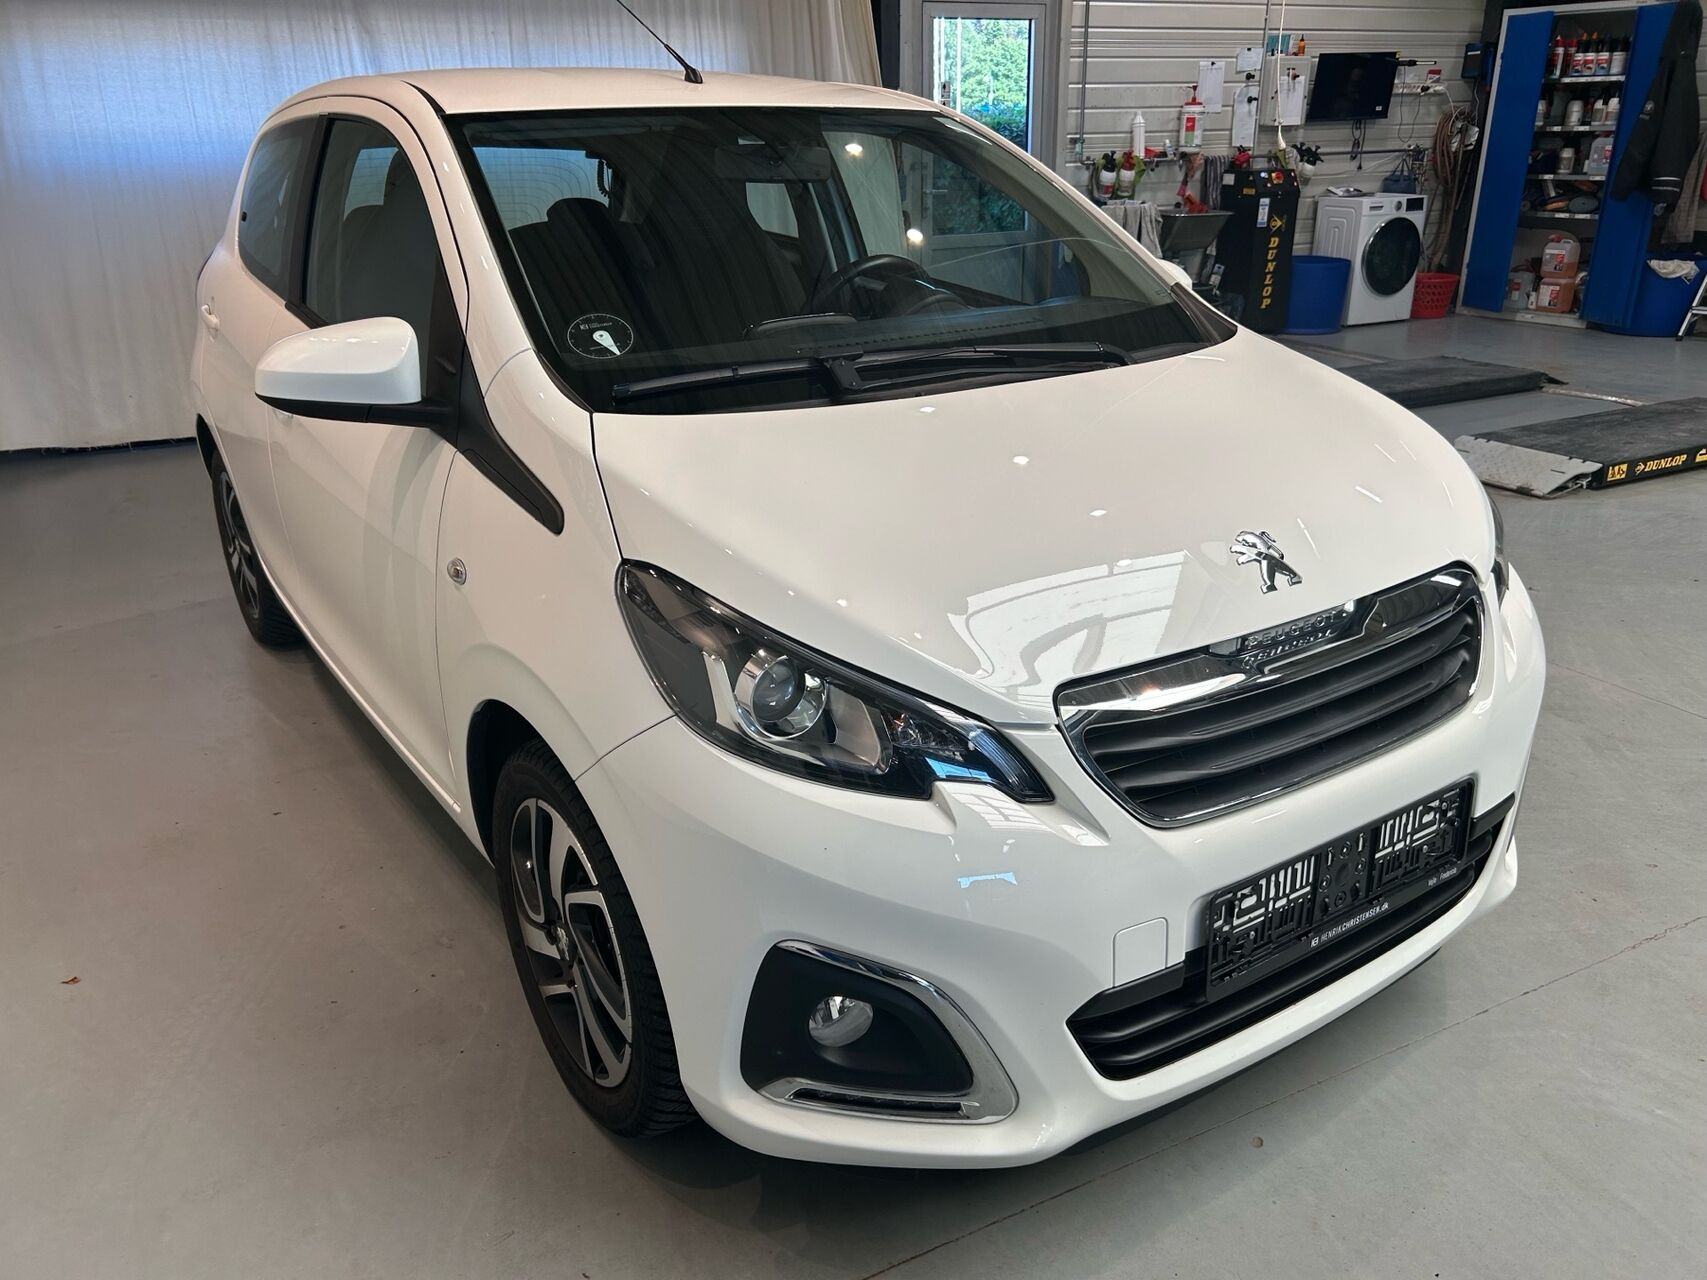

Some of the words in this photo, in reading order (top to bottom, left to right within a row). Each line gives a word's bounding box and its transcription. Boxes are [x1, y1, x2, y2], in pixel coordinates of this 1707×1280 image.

[1260, 237, 1279, 309] DUNLOP
[1644, 454, 1687, 472] DUNLOP
[1244, 610, 1336, 650] PEUGEOT
